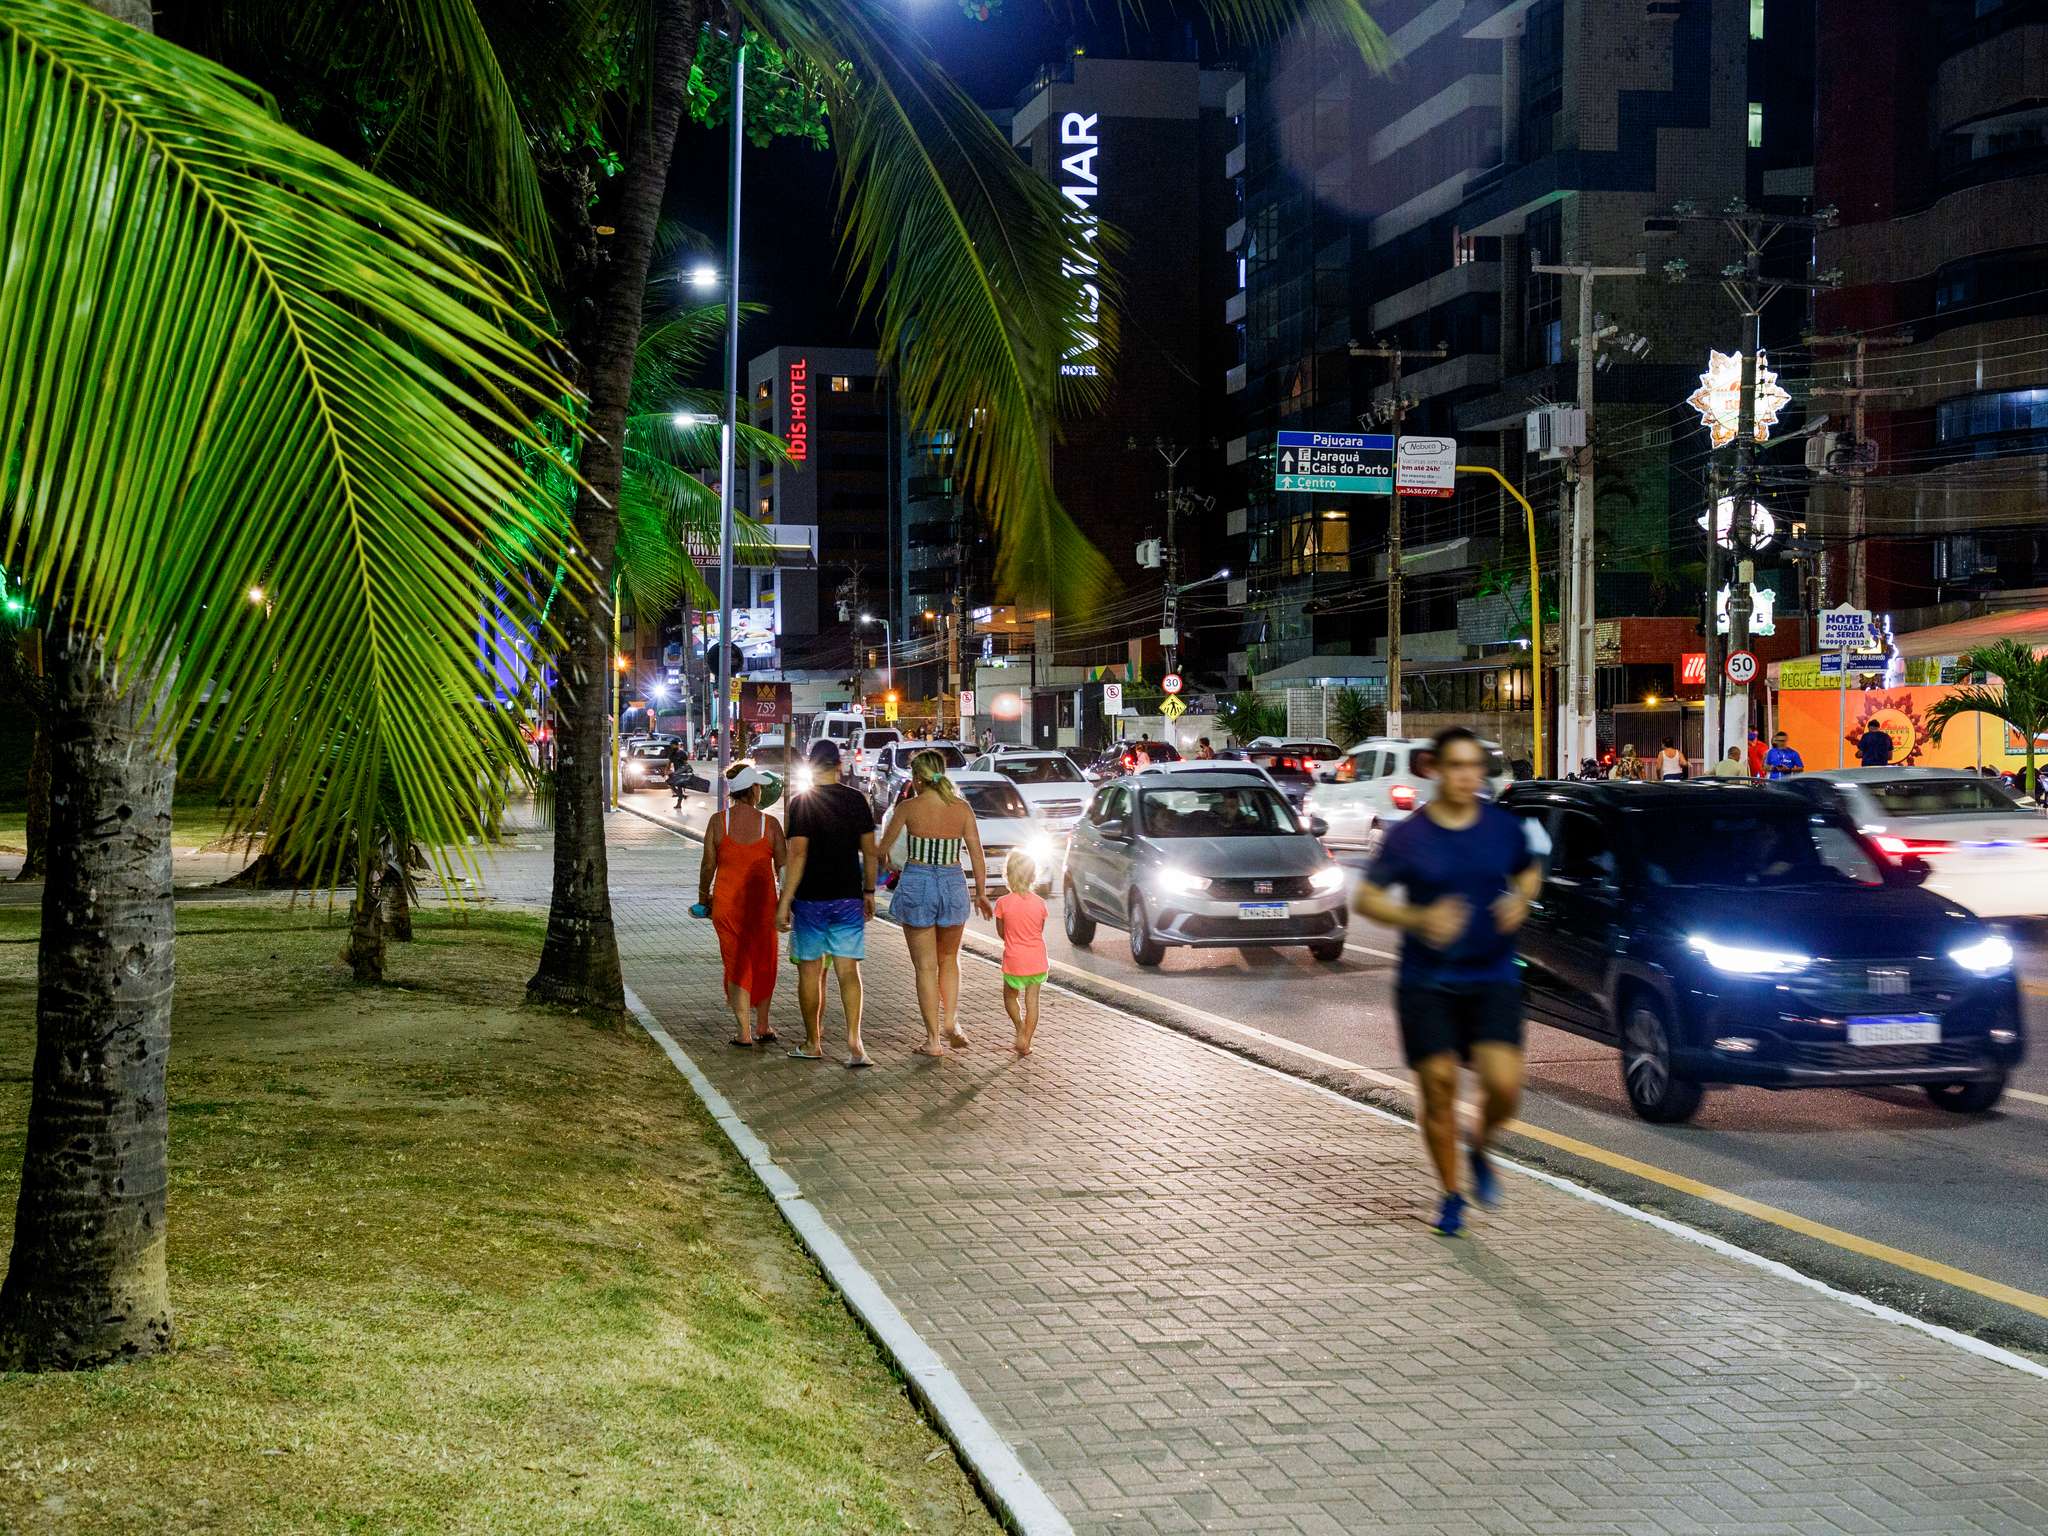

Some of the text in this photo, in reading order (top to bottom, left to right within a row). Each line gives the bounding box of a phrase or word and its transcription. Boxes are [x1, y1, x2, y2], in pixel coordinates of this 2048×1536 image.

[1061, 365, 1099, 376] HOTEL
[786, 359, 807, 460] ibis HOTEL
[1313, 434, 1364, 448] Pajuçara
[1312, 450, 1360, 464] Jaraguá
[1312, 463, 1389, 475] Cais do Porto
[1297, 477, 1337, 488] Centro
[686, 544, 721, 556] TOWE
[693, 558, 721, 566] 122.4000
[1826, 614, 1864, 624] HOTEL
[1684, 657, 1706, 682] illy
[1732, 657, 1753, 673] 50
[1166, 678, 1179, 687] 30
[1781, 671, 1812, 688] PEGUE
[757, 701, 776, 714] 759
